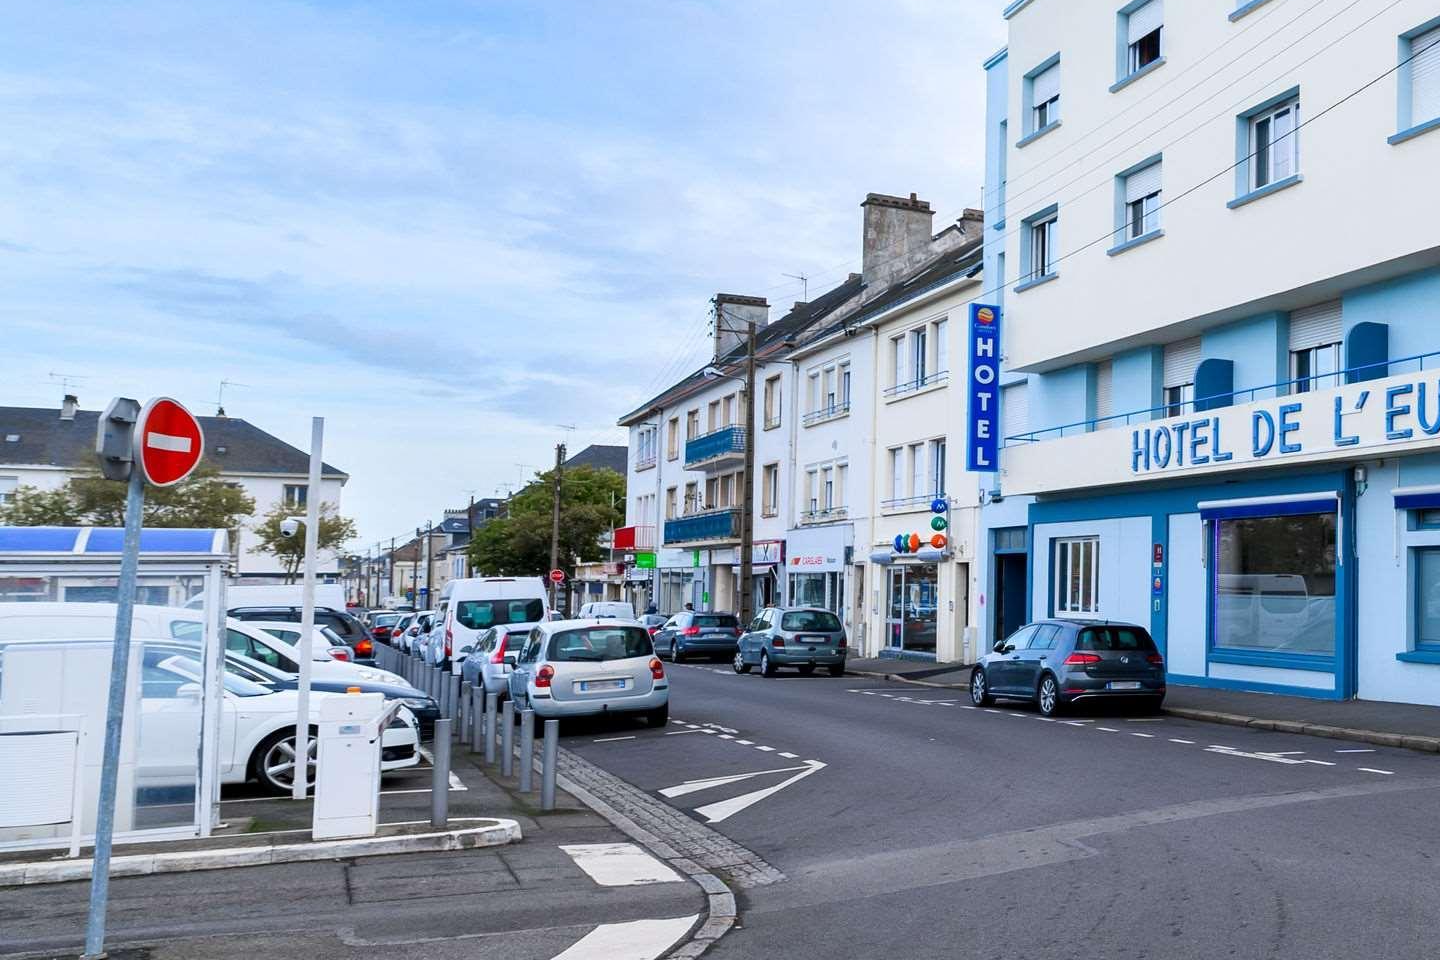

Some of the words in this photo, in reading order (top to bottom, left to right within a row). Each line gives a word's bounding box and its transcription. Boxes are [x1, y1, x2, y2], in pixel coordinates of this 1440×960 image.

[974, 337, 995, 466] HOTEL
[1131, 416, 1233, 472] HOTEL
[1252, 402, 1302, 458] DE
